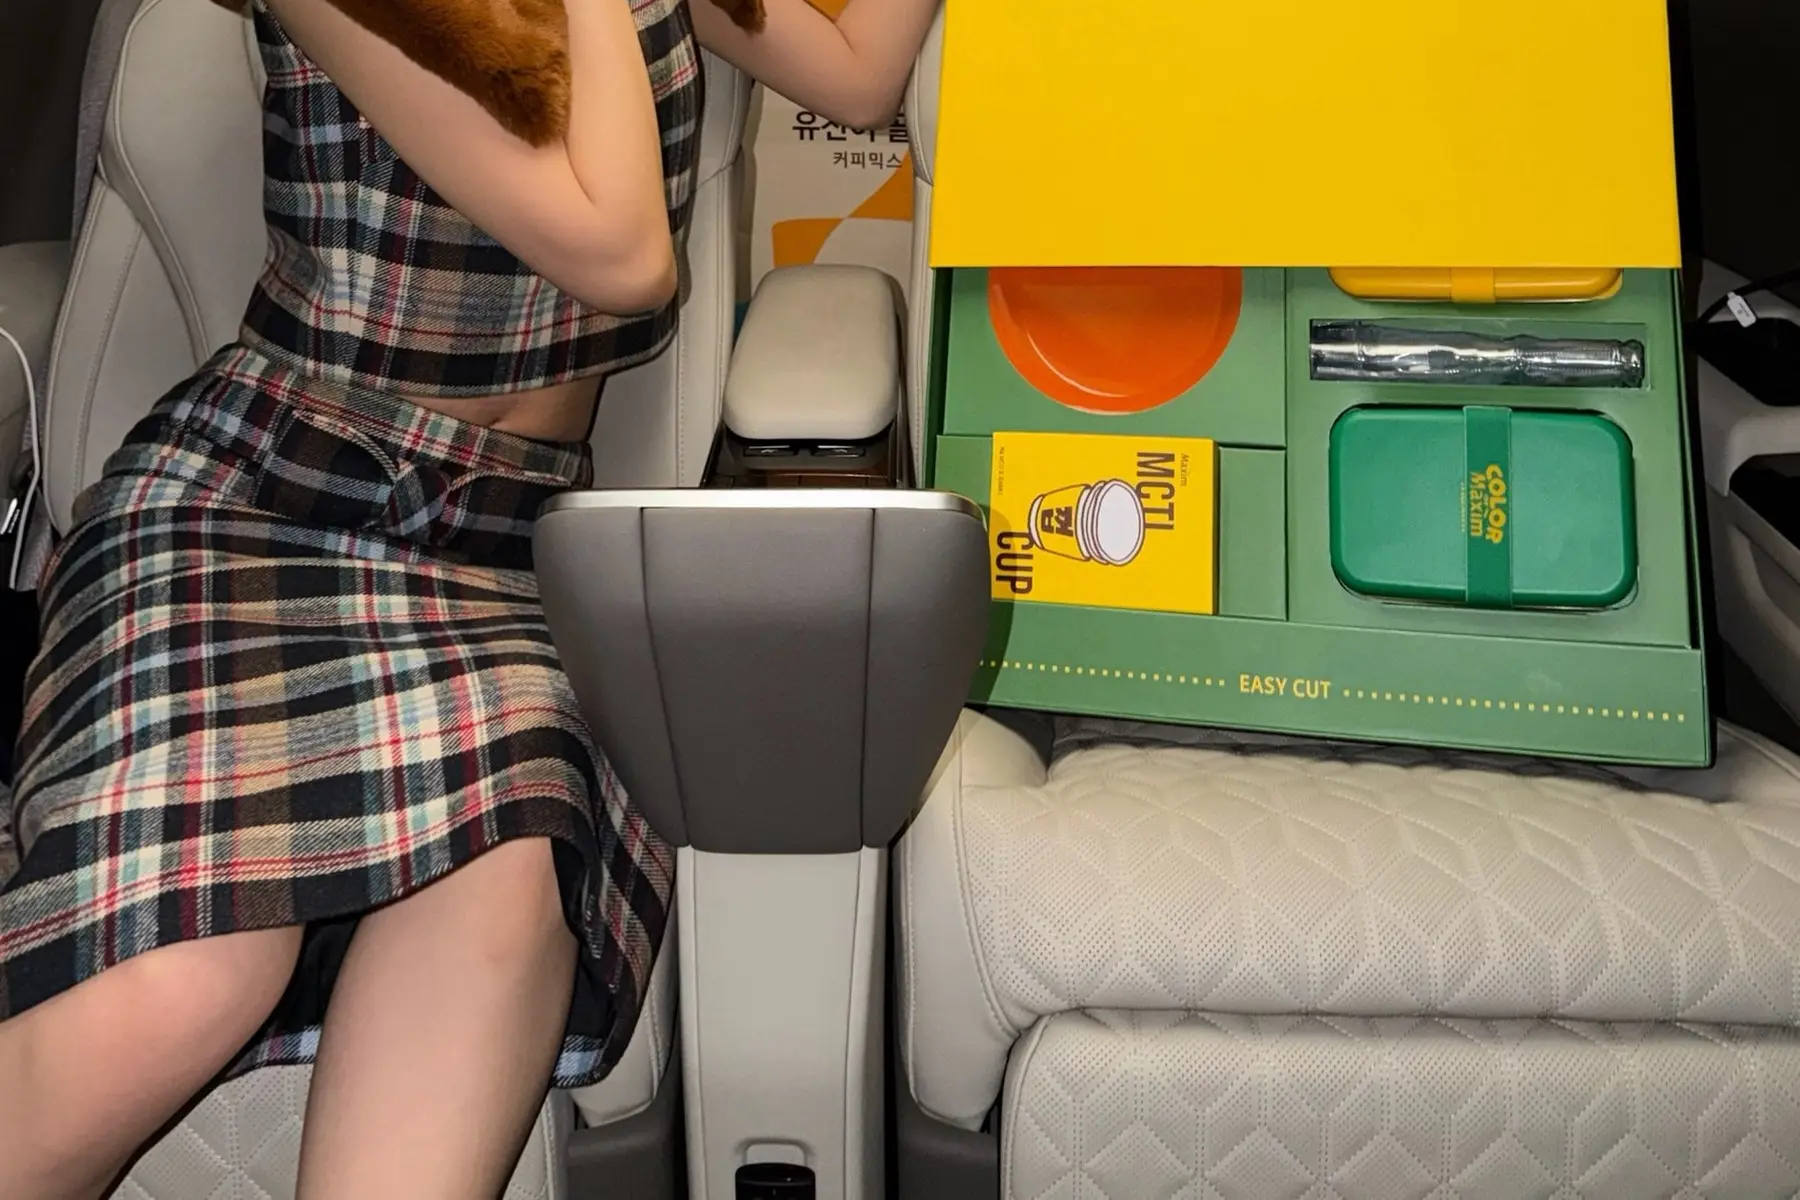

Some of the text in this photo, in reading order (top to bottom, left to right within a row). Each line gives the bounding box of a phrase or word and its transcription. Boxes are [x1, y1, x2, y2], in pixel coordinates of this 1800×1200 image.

[833, 150, 903, 169] 커피믹스
[1136, 451, 1176, 531] MCTI
[1179, 452, 1191, 488] Maxim
[1470, 471, 1486, 537] Maxim
[1486, 464, 1506, 544] COLOR
[995, 531, 1034, 595] CUP
[1239, 673, 1332, 699] EASY CUT
